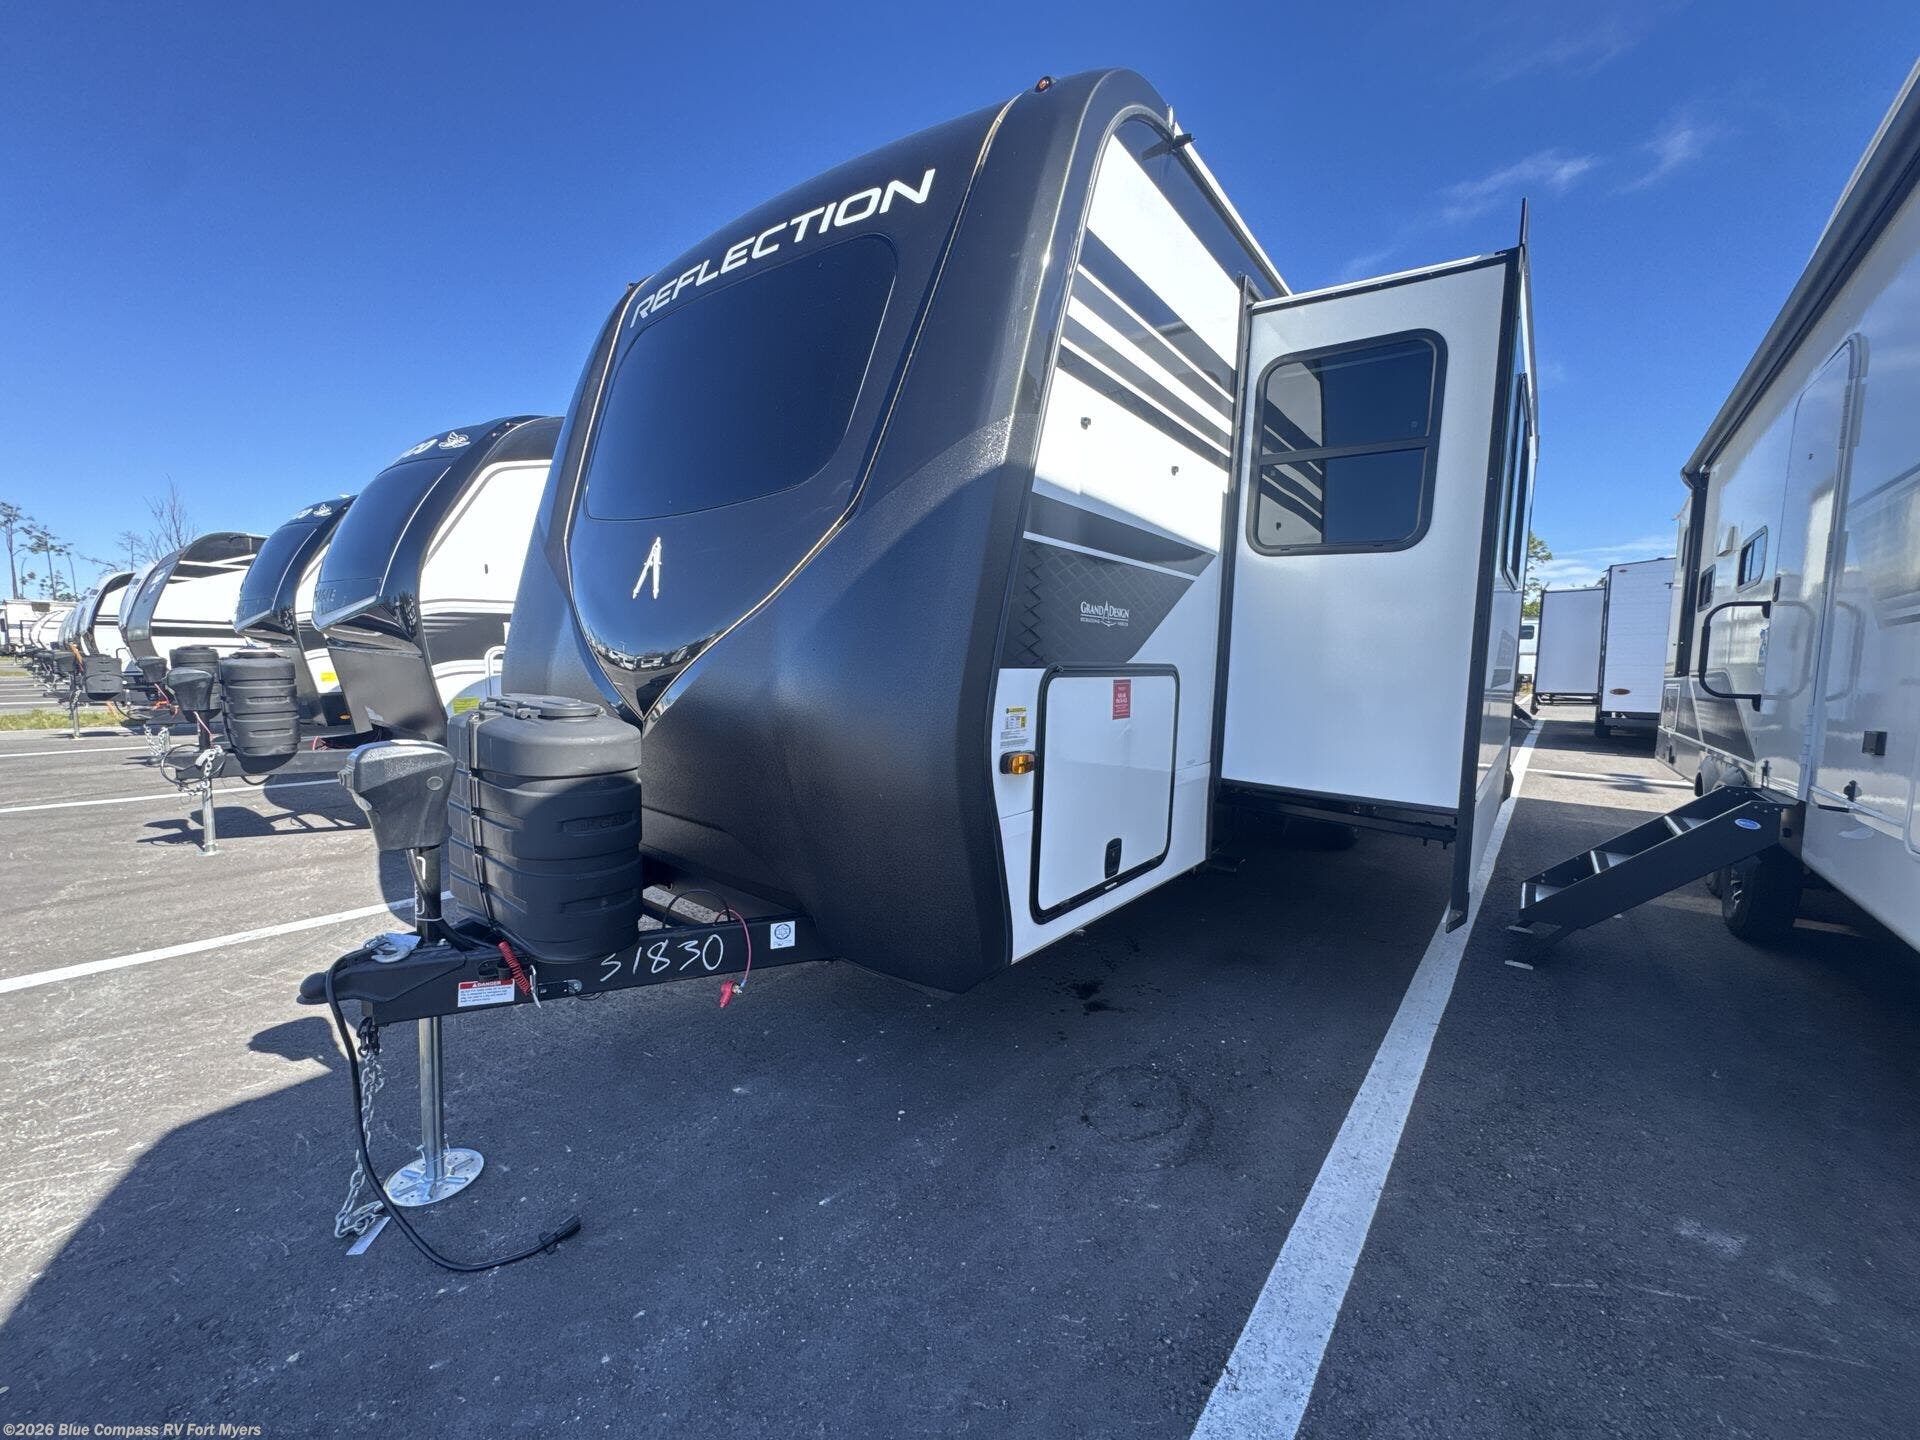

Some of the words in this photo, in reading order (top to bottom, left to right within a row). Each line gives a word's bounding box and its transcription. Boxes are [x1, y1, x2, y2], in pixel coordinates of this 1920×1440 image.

[630, 168, 936, 328] REFLECTION
[1080, 601, 1104, 616] GRAND
[1109, 605, 1130, 619] DESIGN
